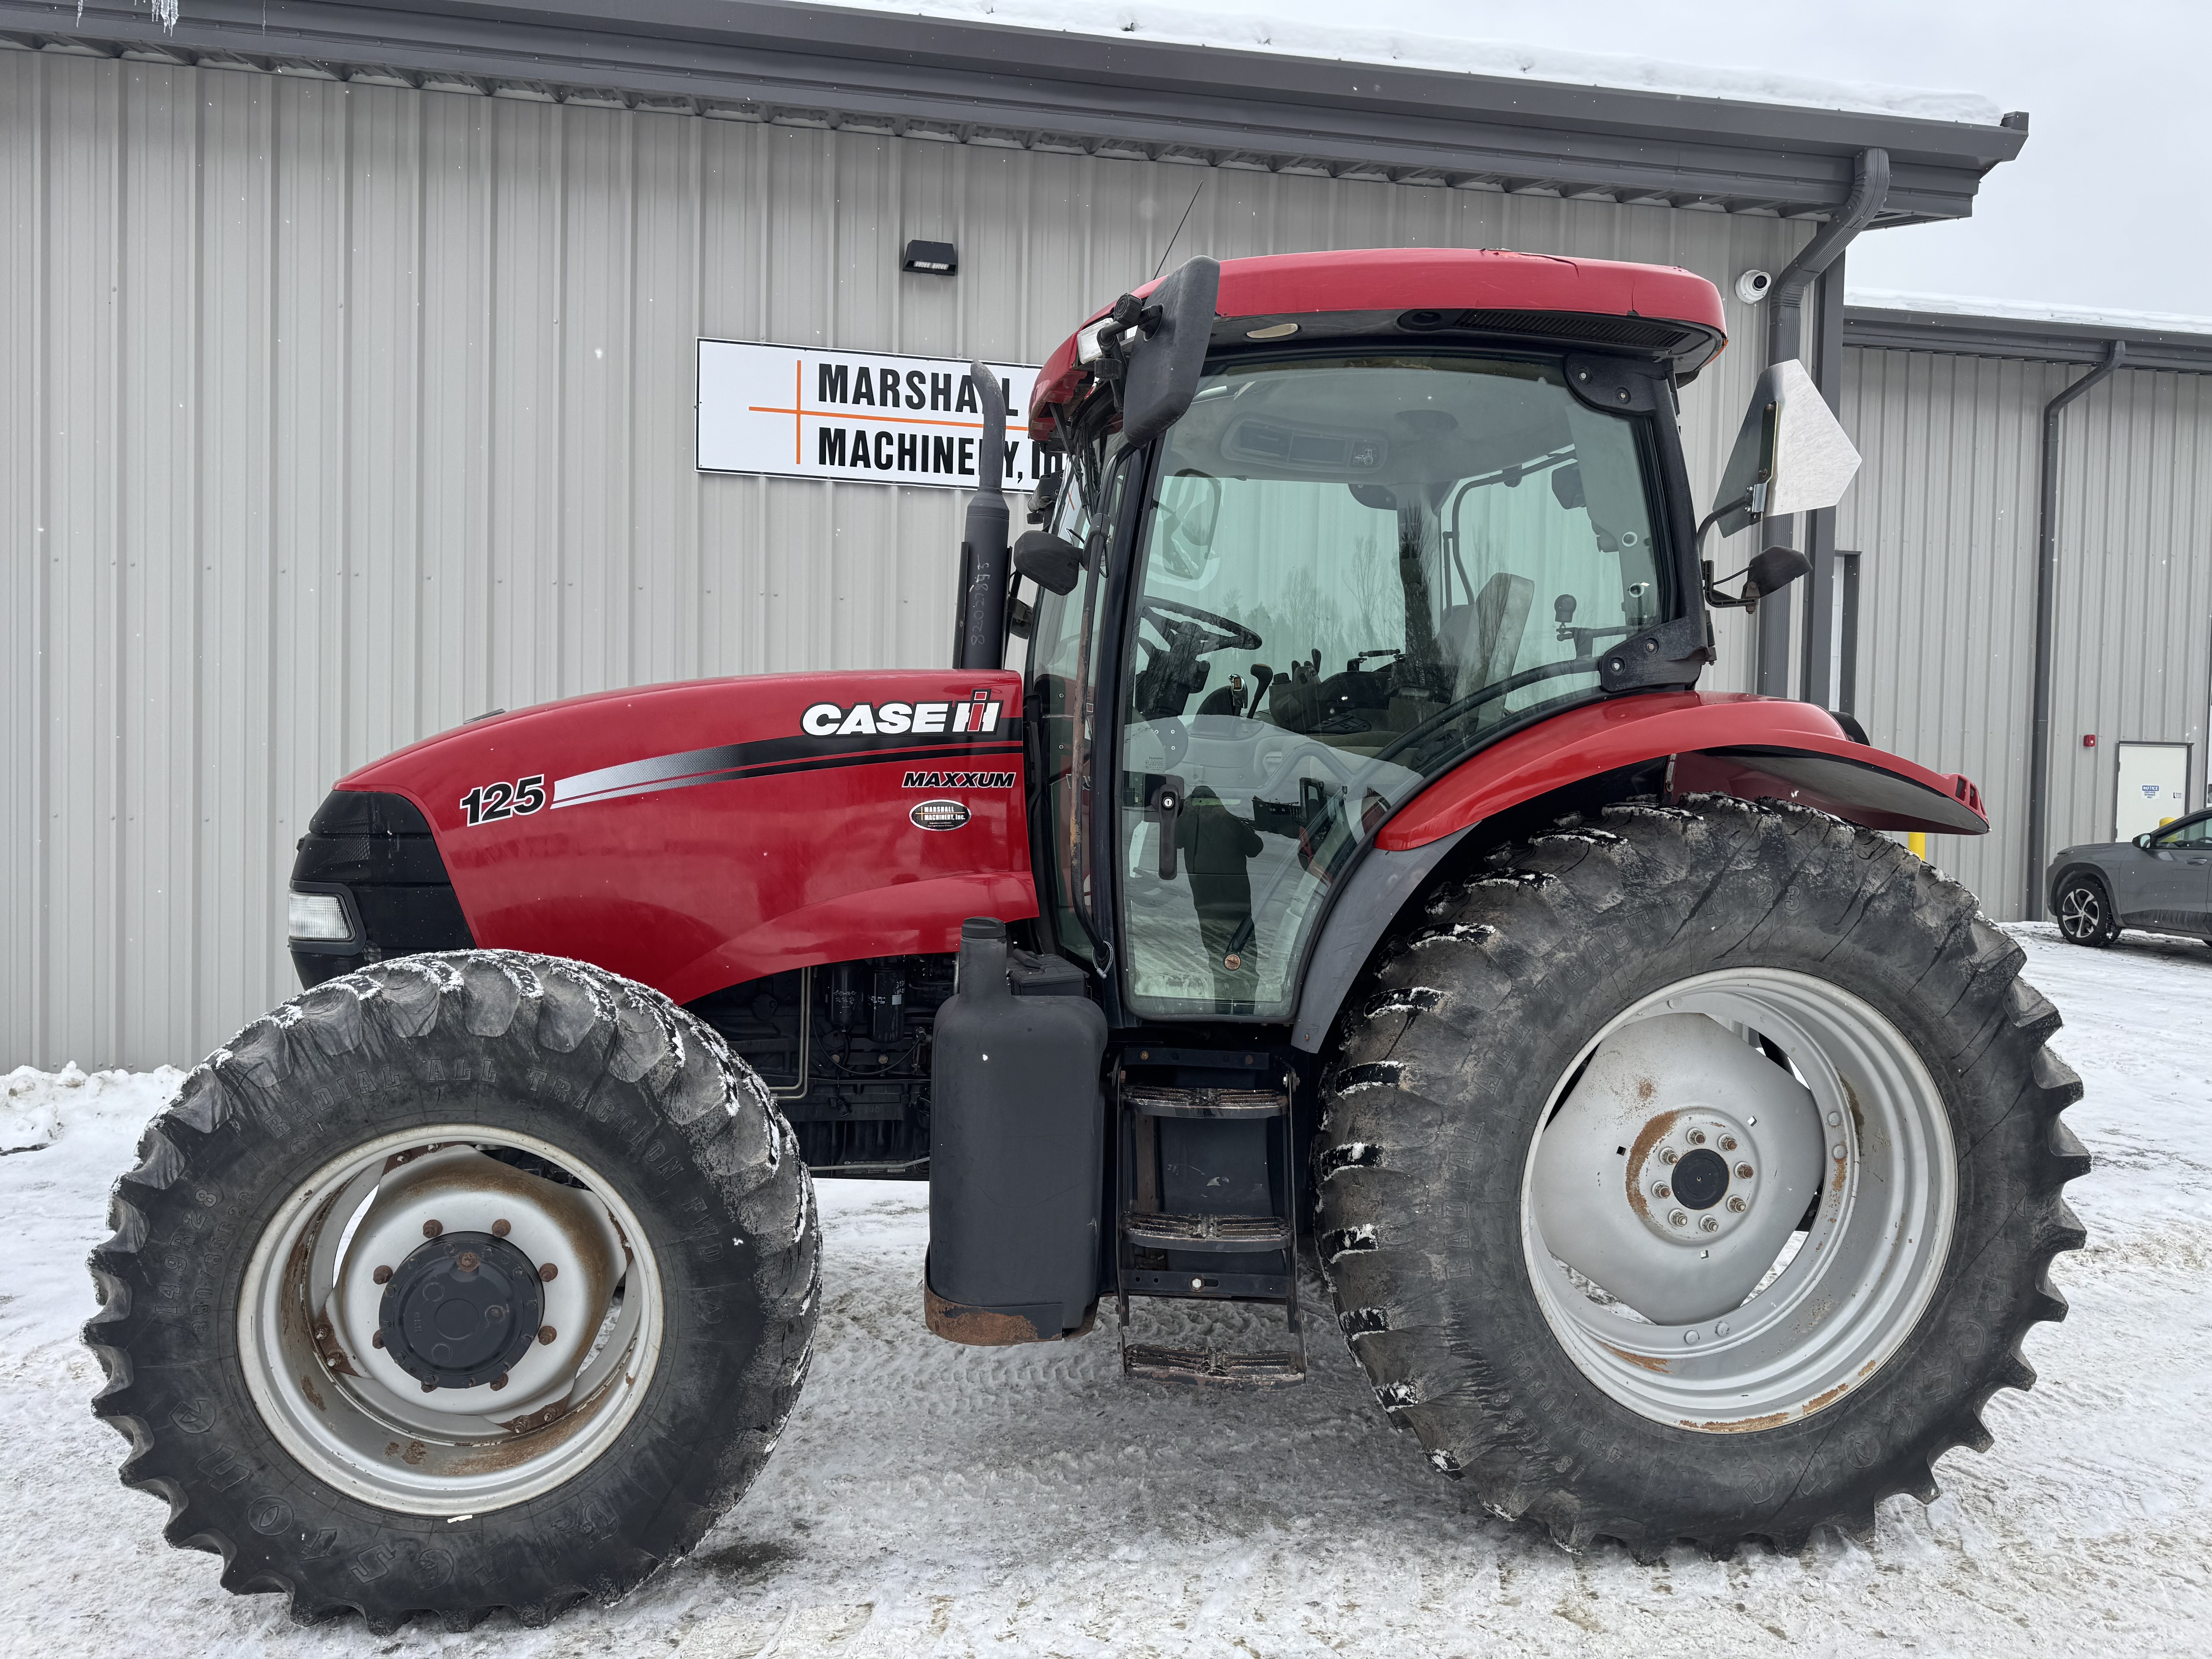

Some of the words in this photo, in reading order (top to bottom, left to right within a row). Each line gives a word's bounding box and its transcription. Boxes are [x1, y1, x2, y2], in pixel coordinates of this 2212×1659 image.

[819, 363, 1018, 417] MARSHAL
[819, 427, 1023, 484] MACHINEY,
[802, 701, 948, 736] CASE
[460, 774, 546, 827] 125
[902, 771, 1016, 788] MAXXUM
[263, 1065, 402, 1139] RADIAL
[429, 1058, 500, 1083] ALL
[526, 1068, 684, 1181] TRACTION
